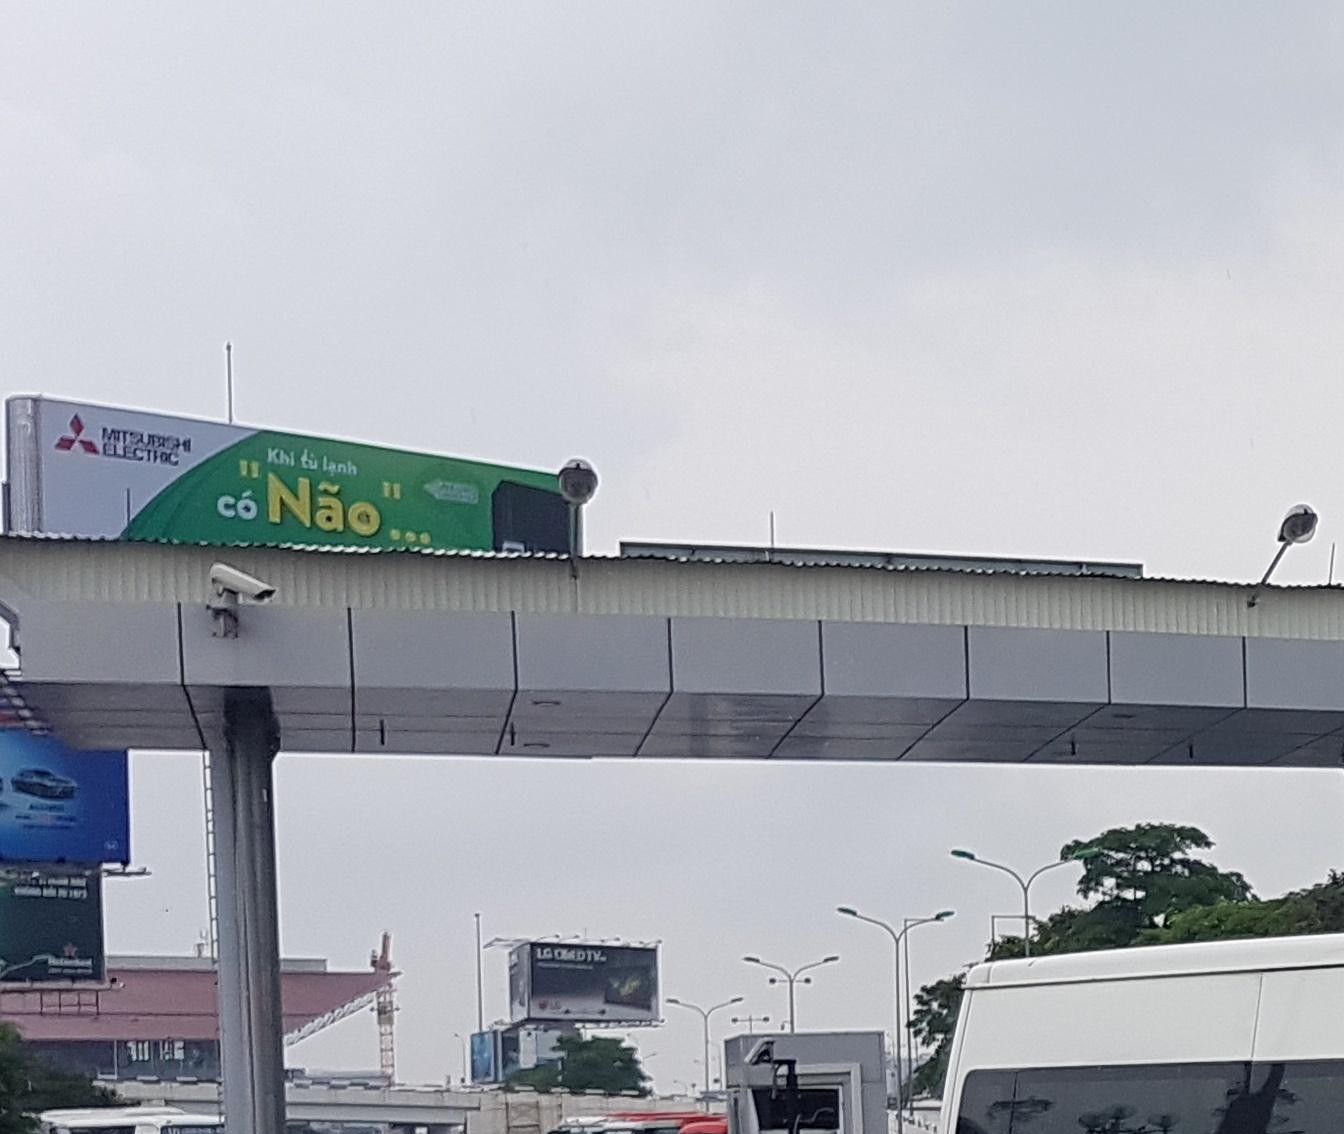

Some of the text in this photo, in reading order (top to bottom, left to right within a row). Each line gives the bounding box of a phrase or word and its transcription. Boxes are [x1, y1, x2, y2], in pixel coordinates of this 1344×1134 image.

[102, 427, 192, 452] MITSUBISHI
[103, 443, 179, 466] ELECTRIC
[267, 449, 295, 465] Khi
[323, 456, 357, 477] lạnh
[217, 490, 257, 520] có
